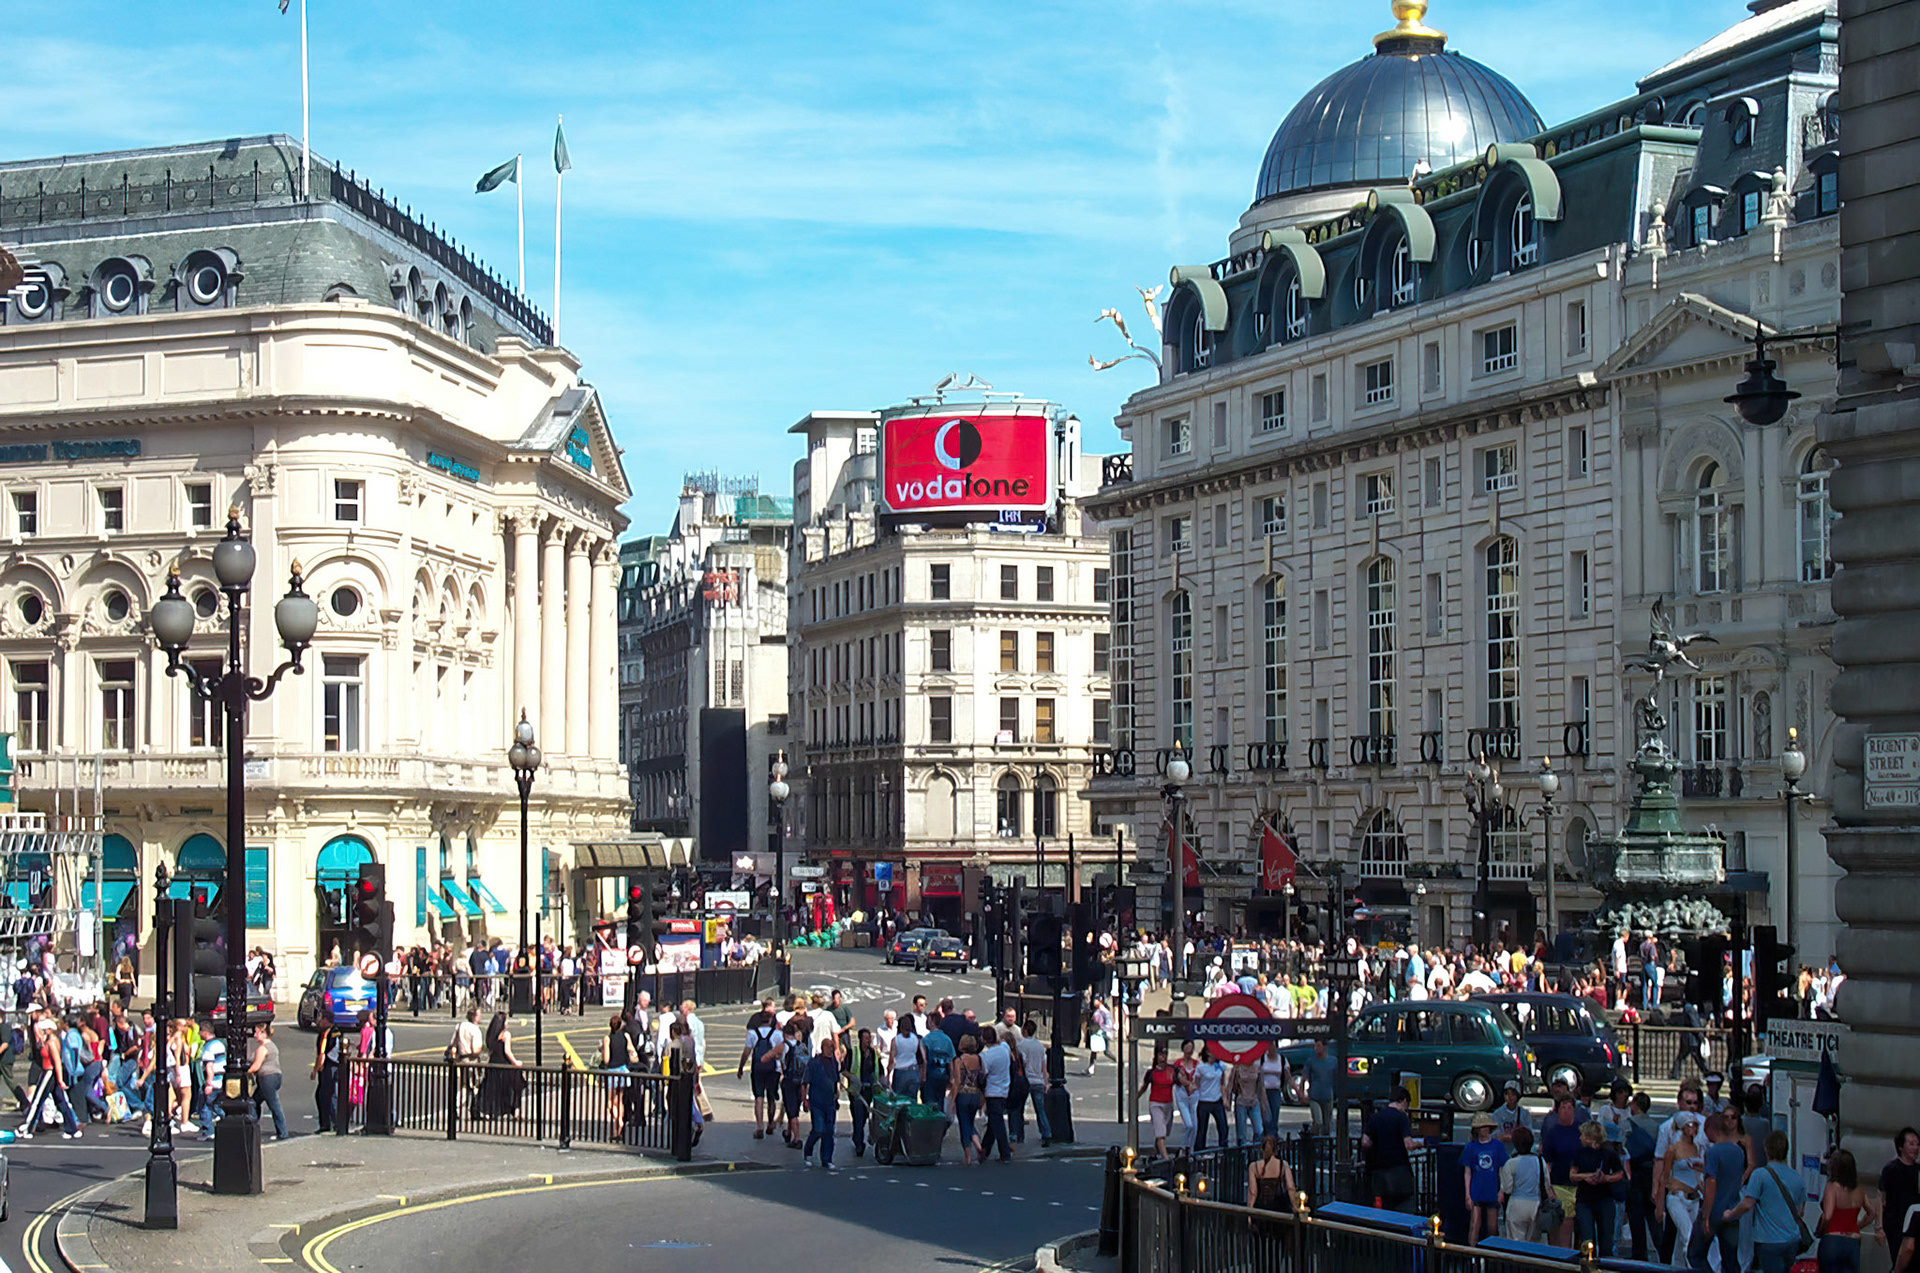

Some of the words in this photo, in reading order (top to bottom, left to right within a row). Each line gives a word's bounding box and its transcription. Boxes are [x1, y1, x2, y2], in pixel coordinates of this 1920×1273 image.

[896, 473, 1029, 502] vodafone
[1869, 739, 1907, 753] REGENT
[1869, 756, 1904, 770] STREET
[1145, 1024, 1176, 1034] PUBLIC
[1193, 1024, 1282, 1035] UNDERGROUND
[1297, 1025, 1331, 1034] SUBWAY
[1768, 1030, 1814, 1050] THEATRE
